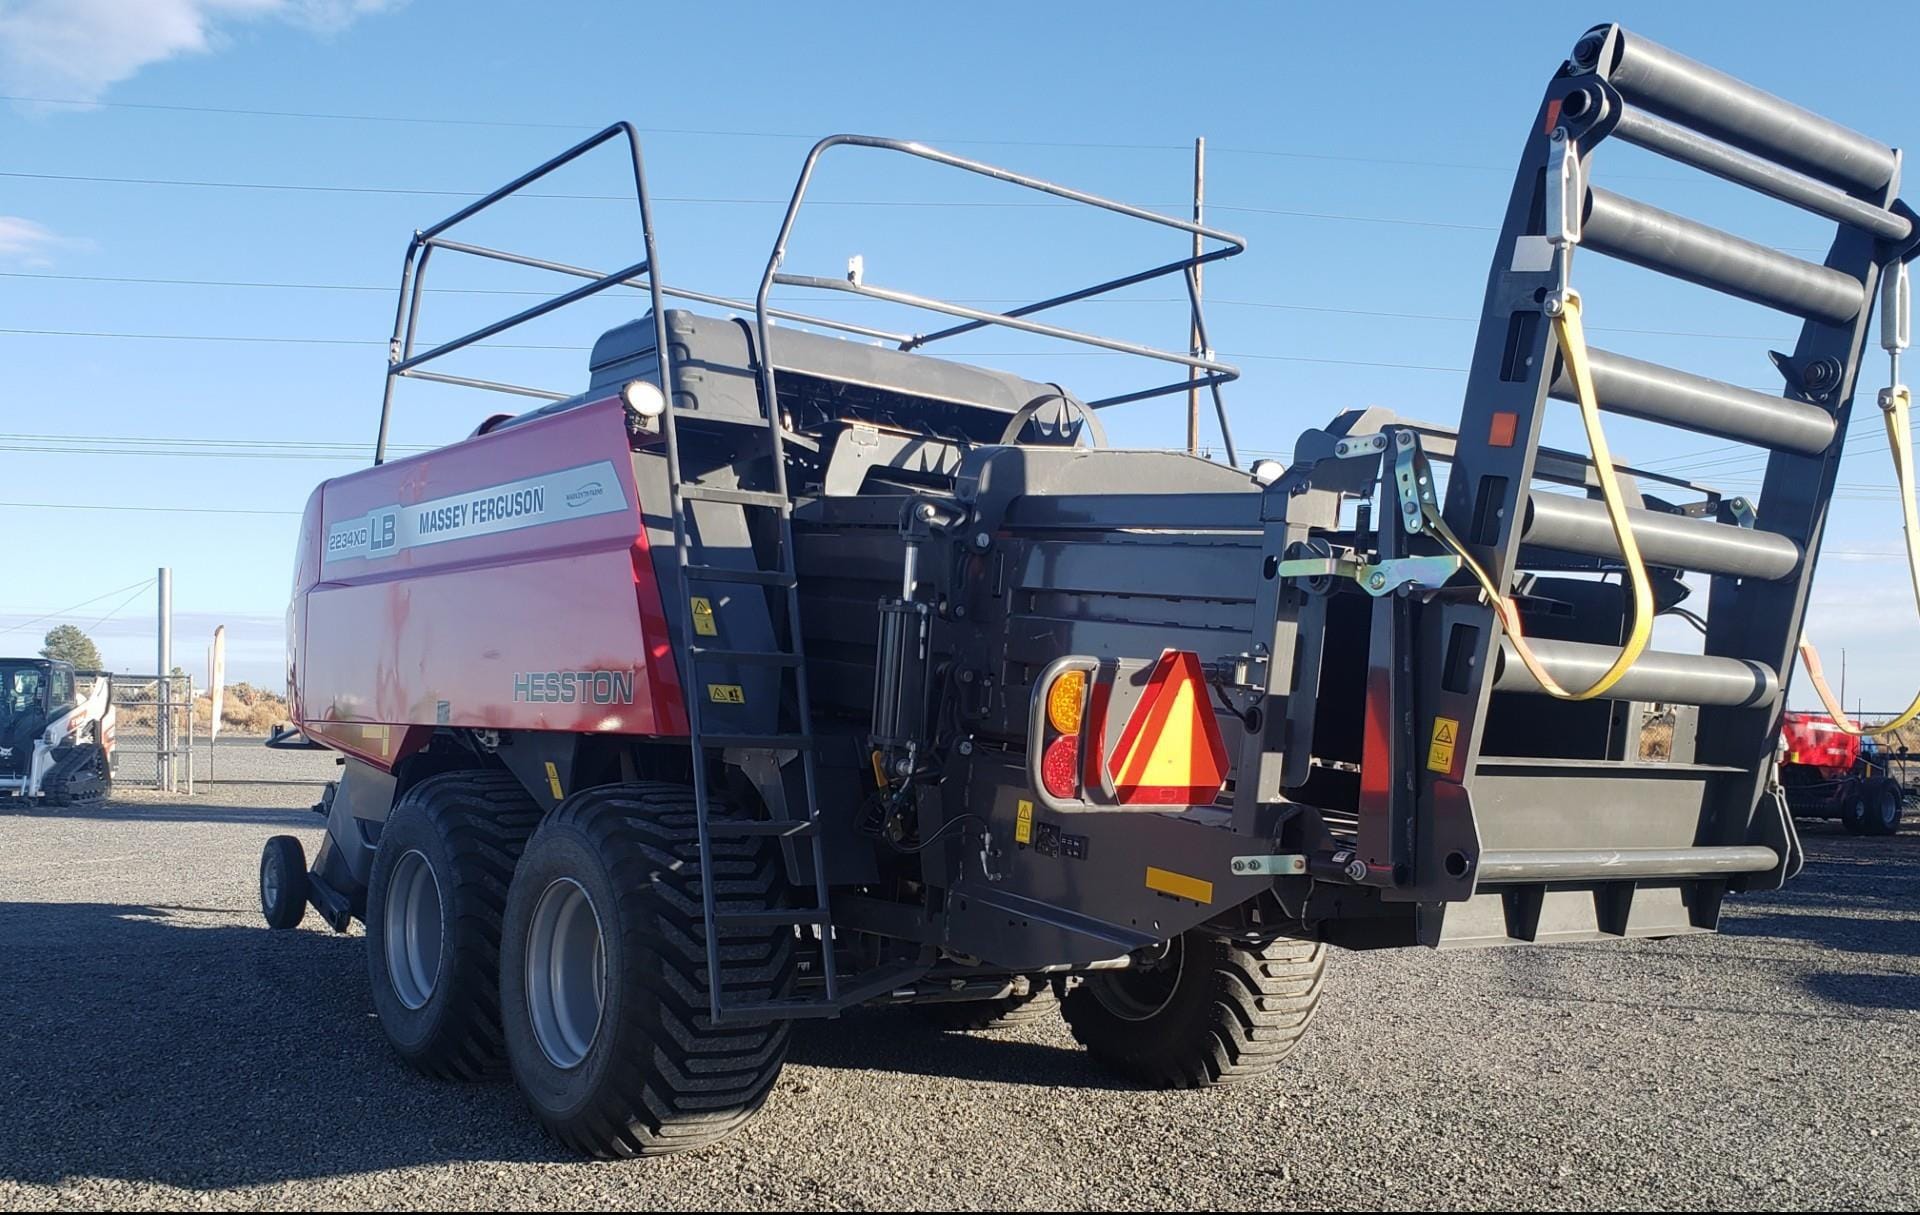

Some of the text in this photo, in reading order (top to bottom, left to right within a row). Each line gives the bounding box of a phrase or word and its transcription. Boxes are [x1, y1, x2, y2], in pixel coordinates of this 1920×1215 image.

[419, 487, 544, 535] MASSEY FERGUSON
[329, 513, 396, 551] 2234XD LB
[512, 671, 633, 704] HESSTON
